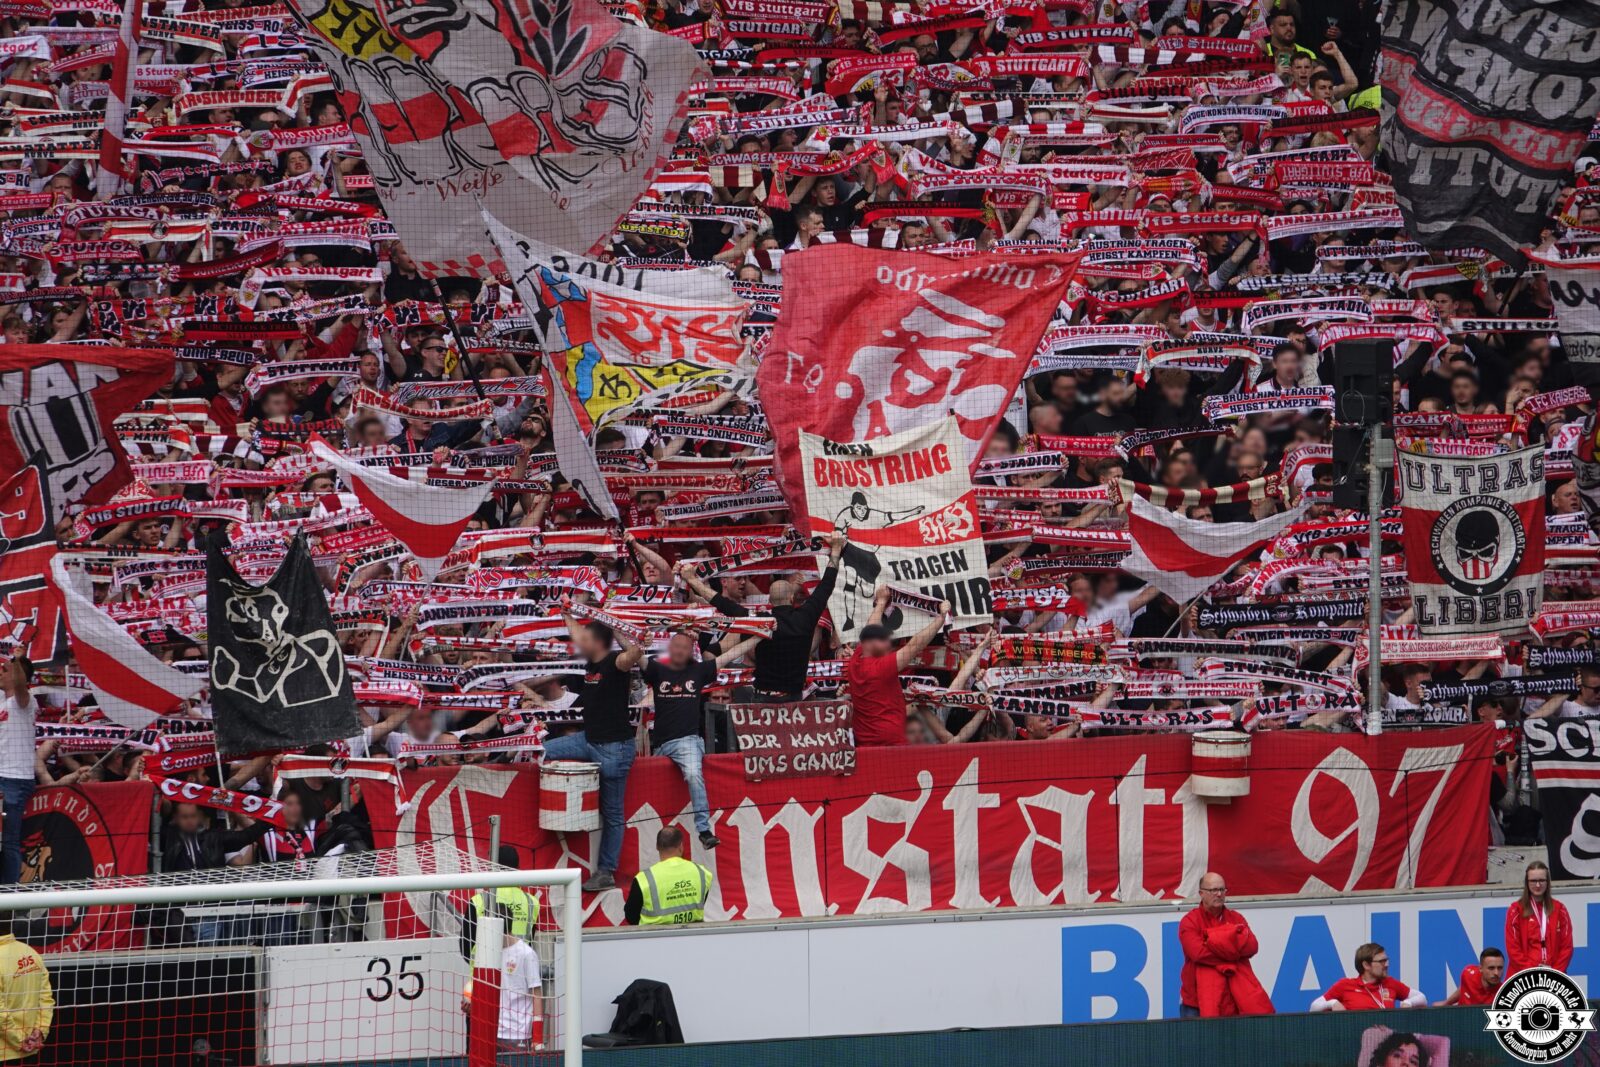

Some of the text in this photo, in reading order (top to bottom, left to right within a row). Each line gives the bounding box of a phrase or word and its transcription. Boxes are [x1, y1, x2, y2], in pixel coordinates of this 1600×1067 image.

[753, 3, 825, 18] Stuttgart
[729, 20, 802, 34] STUTTGAR
[1048, 26, 1133, 41] STUTTGAR
[857, 54, 916, 69] Stuttgart
[996, 58, 1075, 73] STUTTGART
[145, 68, 180, 76] Stuttg
[1207, 109, 1252, 117] KONSTANTE
[1254, 107, 1271, 116] SIND
[750, 112, 833, 130] STUTTGART
[24, 150, 55, 158] KURVE
[713, 154, 778, 164] CHWABEN
[1052, 167, 1127, 181] Stuttgart
[257, 193, 360, 212] DNKELROTER
[636, 204, 718, 216] UTTGARTER
[67, 207, 161, 227] STUTTGA
[1082, 209, 1147, 221] STUTTGA
[1181, 213, 1259, 225] Stuttgar
[50, 241, 135, 254] STUTTGA
[1088, 240, 1187, 251] RUSTRING TRAGEN
[1090, 251, 1124, 261] HEISST
[300, 267, 373, 284] Stuttgart
[1248, 302, 1372, 321] ECKAR STADIO
[1323, 327, 1396, 342] ANNSTATTER
[1285, 388, 1327, 398] TRAGEN
[1549, 387, 1591, 406] KAISERSL
[1229, 401, 1266, 412] HEISST
[1394, 412, 1450, 425] TGART
[1072, 441, 1117, 450] Stutt
[1433, 443, 1494, 456] STUTTGART
[399, 453, 433, 466] WEIS
[812, 443, 952, 489] BRUSTRING
[1000, 454, 1063, 469] STADION
[1285, 446, 1332, 474] STUTTGART
[1404, 454, 1545, 494] ULTRAS
[707, 498, 755, 514] KONSTANTE
[1432, 496, 1526, 556] SCHWABEN KOMPANIE STUTTGART
[1548, 524, 1589, 534] TRAGEN
[1293, 526, 1319, 542] VfB
[887, 551, 978, 581] TRAGEN
[991, 585, 1066, 599] Cannsta
[1034, 595, 1070, 608] 97
[1415, 587, 1538, 623] LIBERI
[1199, 608, 1270, 628] Schwaben
[1529, 644, 1594, 667] Schwaben
[383, 670, 424, 680] HEISST
[1254, 693, 1359, 717] ULTRA
[520, 708, 585, 724] COMM
[729, 704, 851, 726] ULTRA IST
[737, 728, 853, 751] DER KAMPF
[744, 750, 856, 775] UMS GANZE
[160, 777, 205, 800] CC
[240, 793, 284, 819] 97
[1290, 743, 1464, 895] 97
[673, 880, 692, 888] SDS
[17, 955, 37, 975] SDS
[366, 955, 424, 1002] 35
